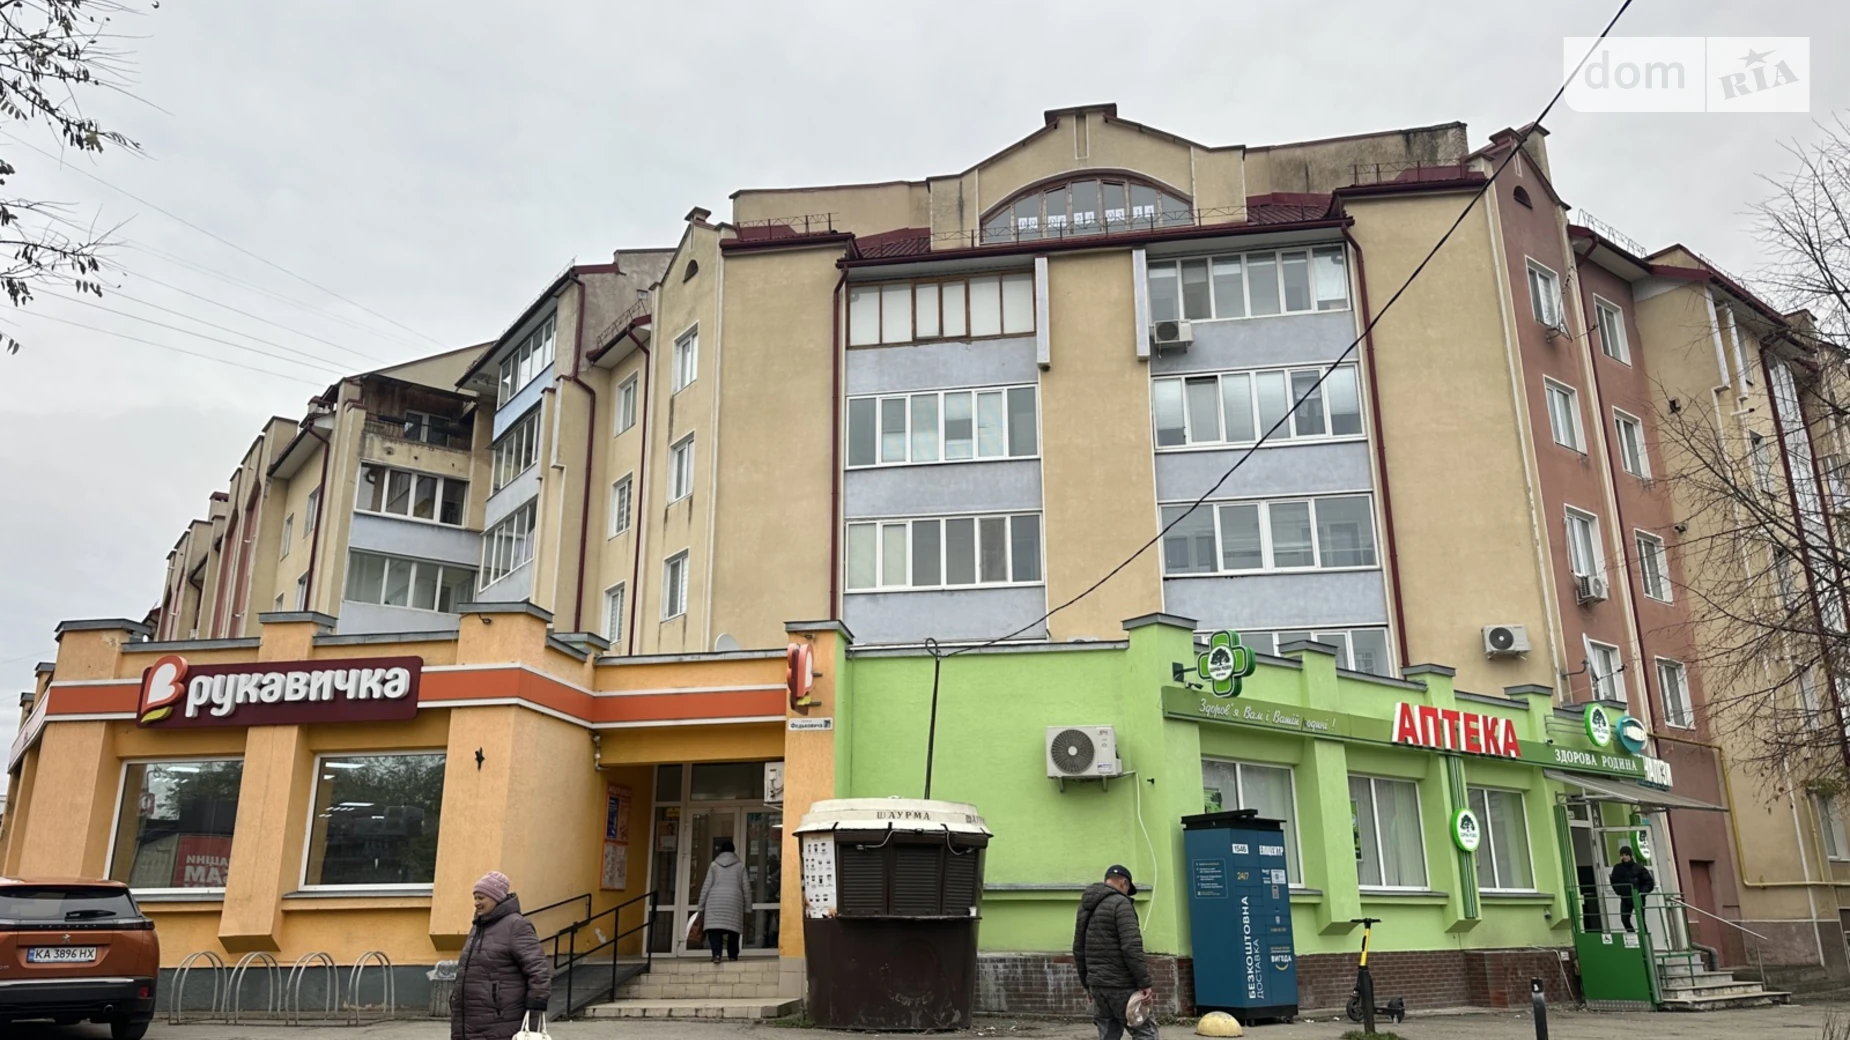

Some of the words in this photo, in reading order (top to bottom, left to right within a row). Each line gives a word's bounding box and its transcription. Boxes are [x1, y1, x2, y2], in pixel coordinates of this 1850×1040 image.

[185, 667, 410, 718] рукавичка
[1243, 705, 1263, 720] Вам
[1391, 702, 1522, 758] АПТЕКА
[1554, 748, 1598, 767] ЗДОРОВА
[1601, 755, 1638, 771] РОДИНА
[877, 810, 931, 821] ШАУРМА
[35, 949, 51, 960] KA
[53, 948, 77, 959] 3896
[79, 948, 95, 959] HX
[1241, 896, 1257, 999] БЕЗКОШТОВНА
[1252, 938, 1265, 999] ДОСТАВКА
